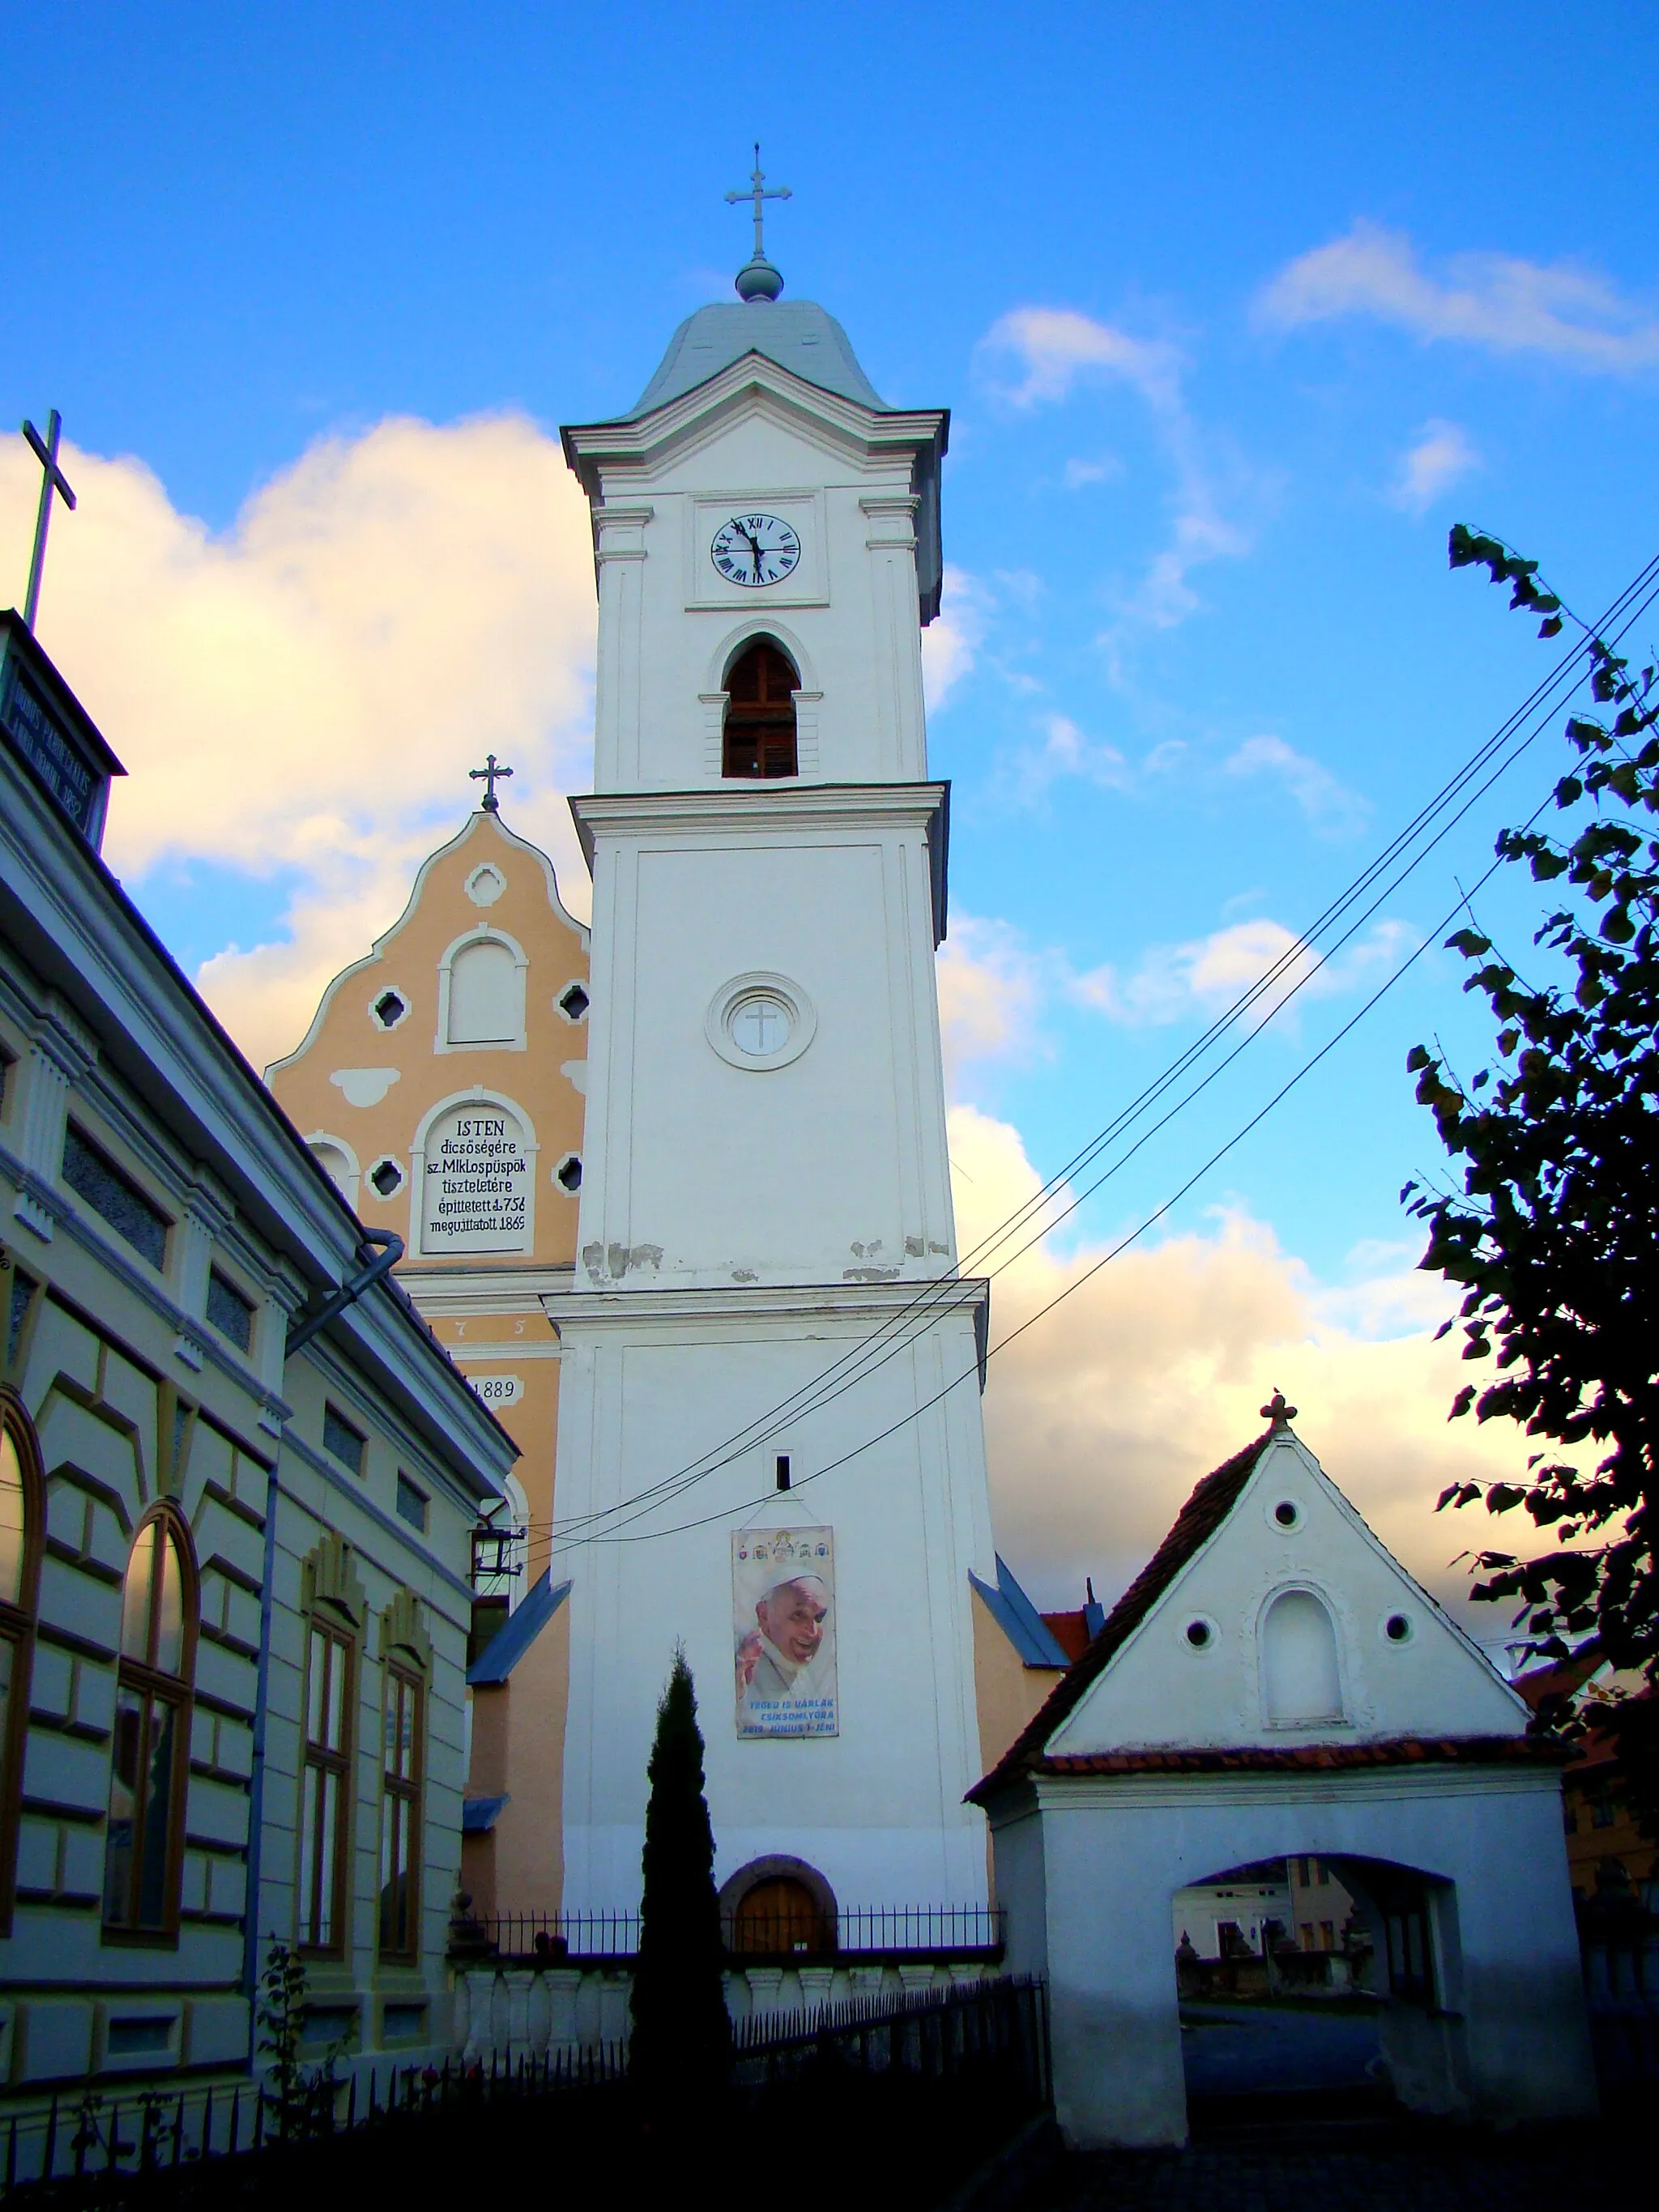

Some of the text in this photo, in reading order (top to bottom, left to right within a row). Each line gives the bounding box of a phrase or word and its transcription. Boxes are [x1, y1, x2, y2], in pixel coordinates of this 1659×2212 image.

[747, 518, 763, 530] XII
[767, 520, 774, 531] I
[719, 534, 733, 543] X
[779, 531, 792, 541] II
[783, 544, 796, 554] III
[732, 569, 747, 582] VII
[767, 569, 778, 581] V
[457, 1120, 505, 1136] ISTEN
[441, 1139, 516, 1157] dicsőségére
[441, 1177, 513, 1194] tiszteletére
[493, 1196, 525, 1212] 1756
[499, 1216, 525, 1230] 1869
[455, 1320, 526, 1336] 7 5
[474, 1381, 514, 1398] 1889
